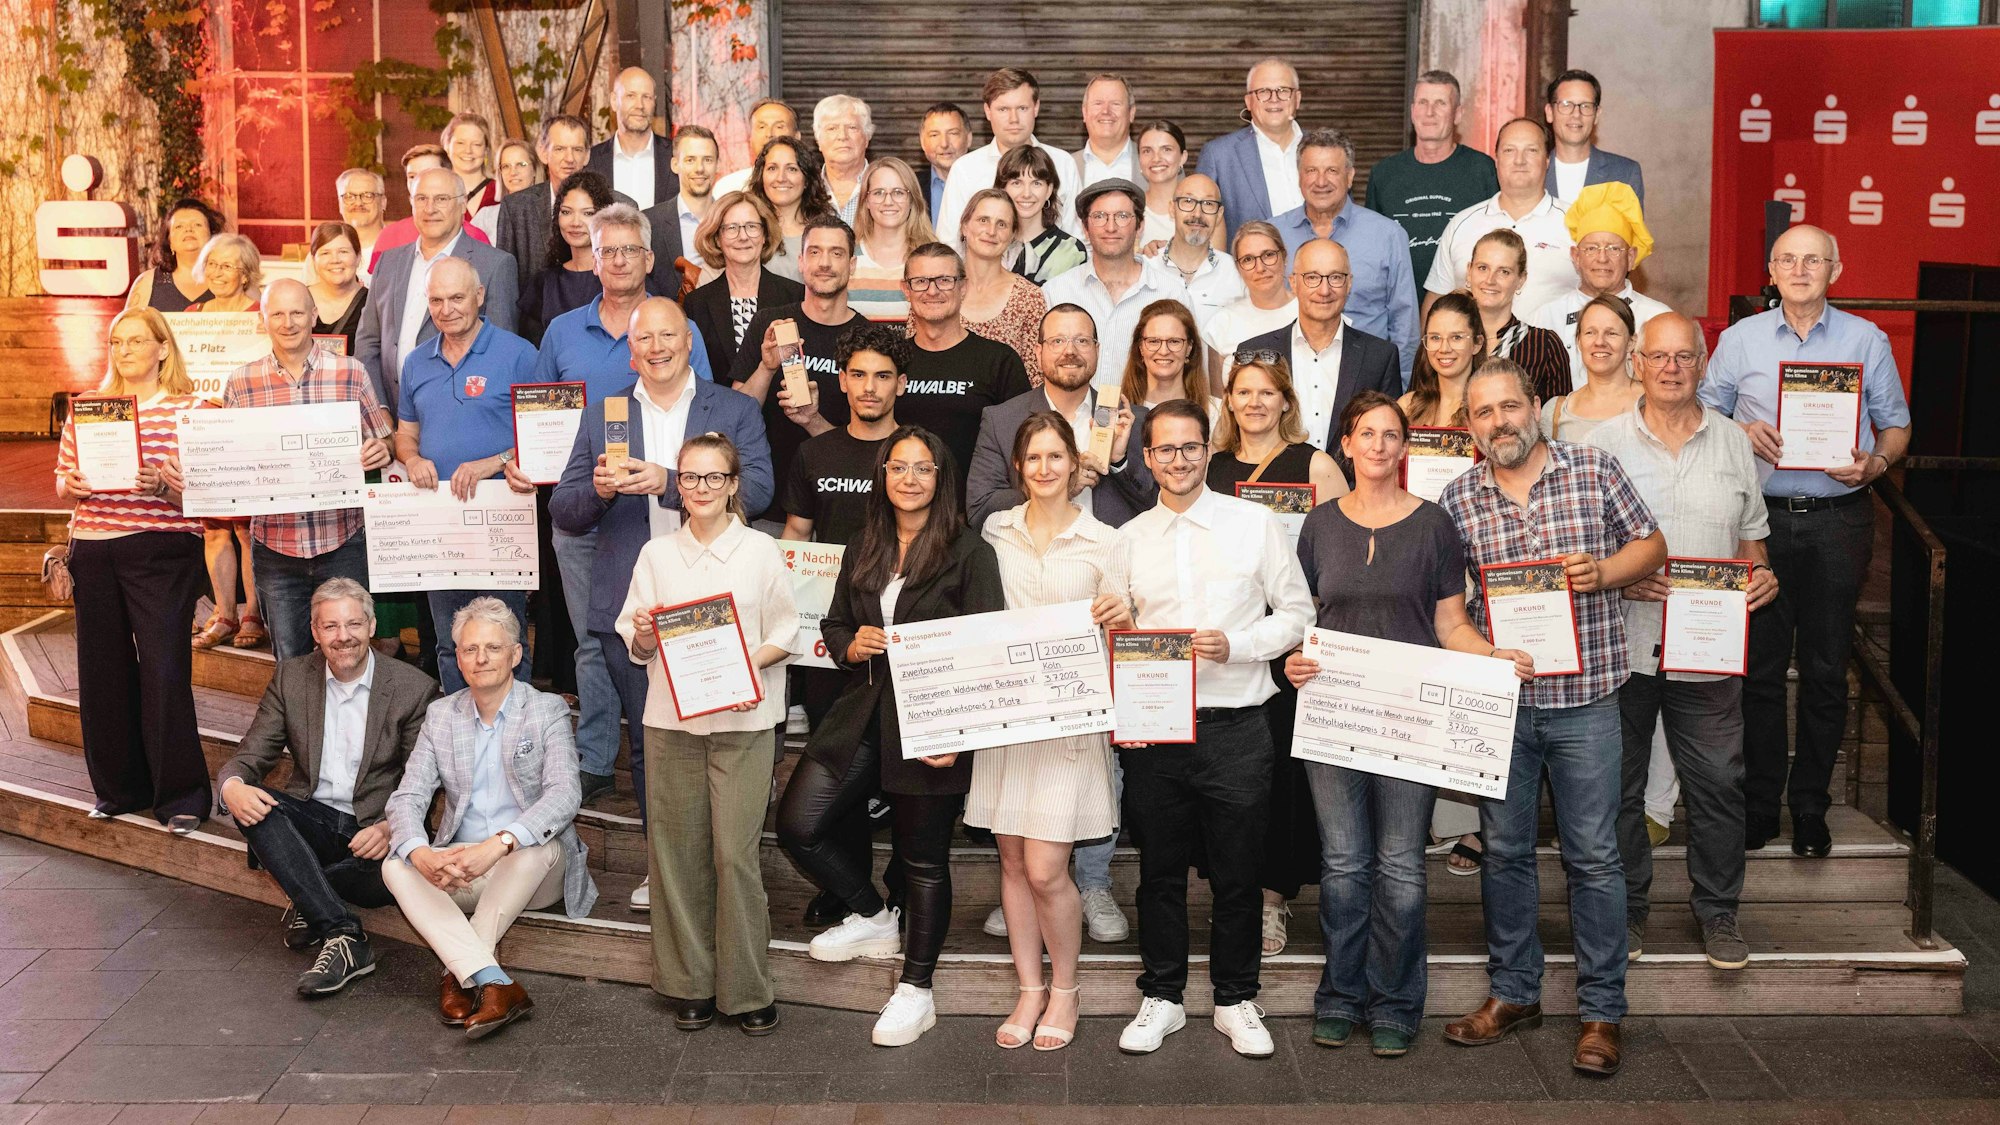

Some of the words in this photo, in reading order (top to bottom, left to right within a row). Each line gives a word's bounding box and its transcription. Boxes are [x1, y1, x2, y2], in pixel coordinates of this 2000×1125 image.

[200, 343, 226, 353] Platz
[262, 476, 280, 484] Platz
[447, 550, 465, 559] Platz
[802, 551, 840, 565] Nachh
[801, 568, 815, 577] der
[817, 568, 838, 579] Kreis
[665, 609, 691, 619] gemeinsam
[1514, 605, 1545, 613] URKUNDE
[904, 630, 952, 642] Kreissparkasse
[687, 638, 717, 650] URKUNDE
[1321, 640, 1371, 655] Kreissparkasse
[1320, 649, 1335, 657] Köln
[902, 663, 954, 679] zweitausend
[1312, 673, 1361, 687] weitausend
[952, 683, 993, 694] Waldwichtel
[908, 703, 987, 720] Nachhaltigkeitspreis
[999, 697, 1021, 707] Platz
[1404, 714, 1415, 722] und
[1416, 716, 1434, 726] Natur
[1305, 712, 1378, 734] Nachhaltigkeitspreis
[1391, 728, 1412, 741] Platz
